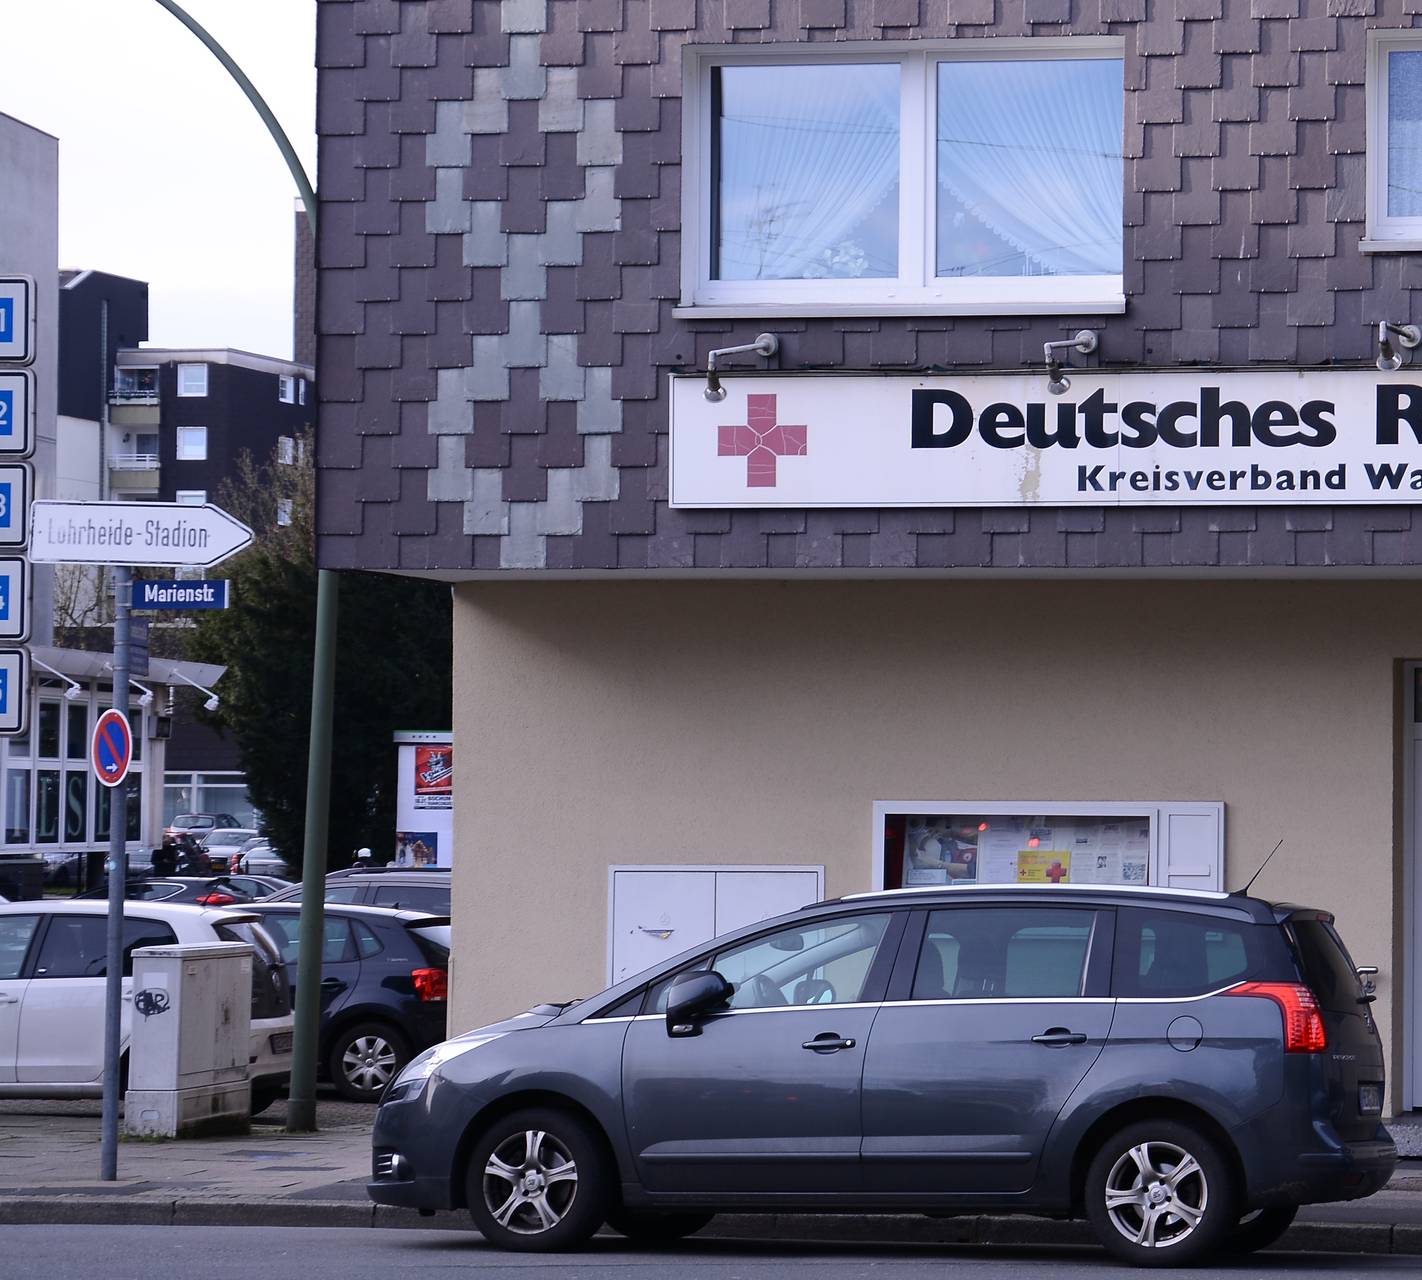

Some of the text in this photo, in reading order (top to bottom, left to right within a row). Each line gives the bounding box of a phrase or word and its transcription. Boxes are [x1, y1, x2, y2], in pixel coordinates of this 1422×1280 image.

[911, 386, 1337, 449] Deutsches
[1077, 463, 1347, 492] Kreisverband
[48, 518, 208, 549] Lohrheide-Stadion
